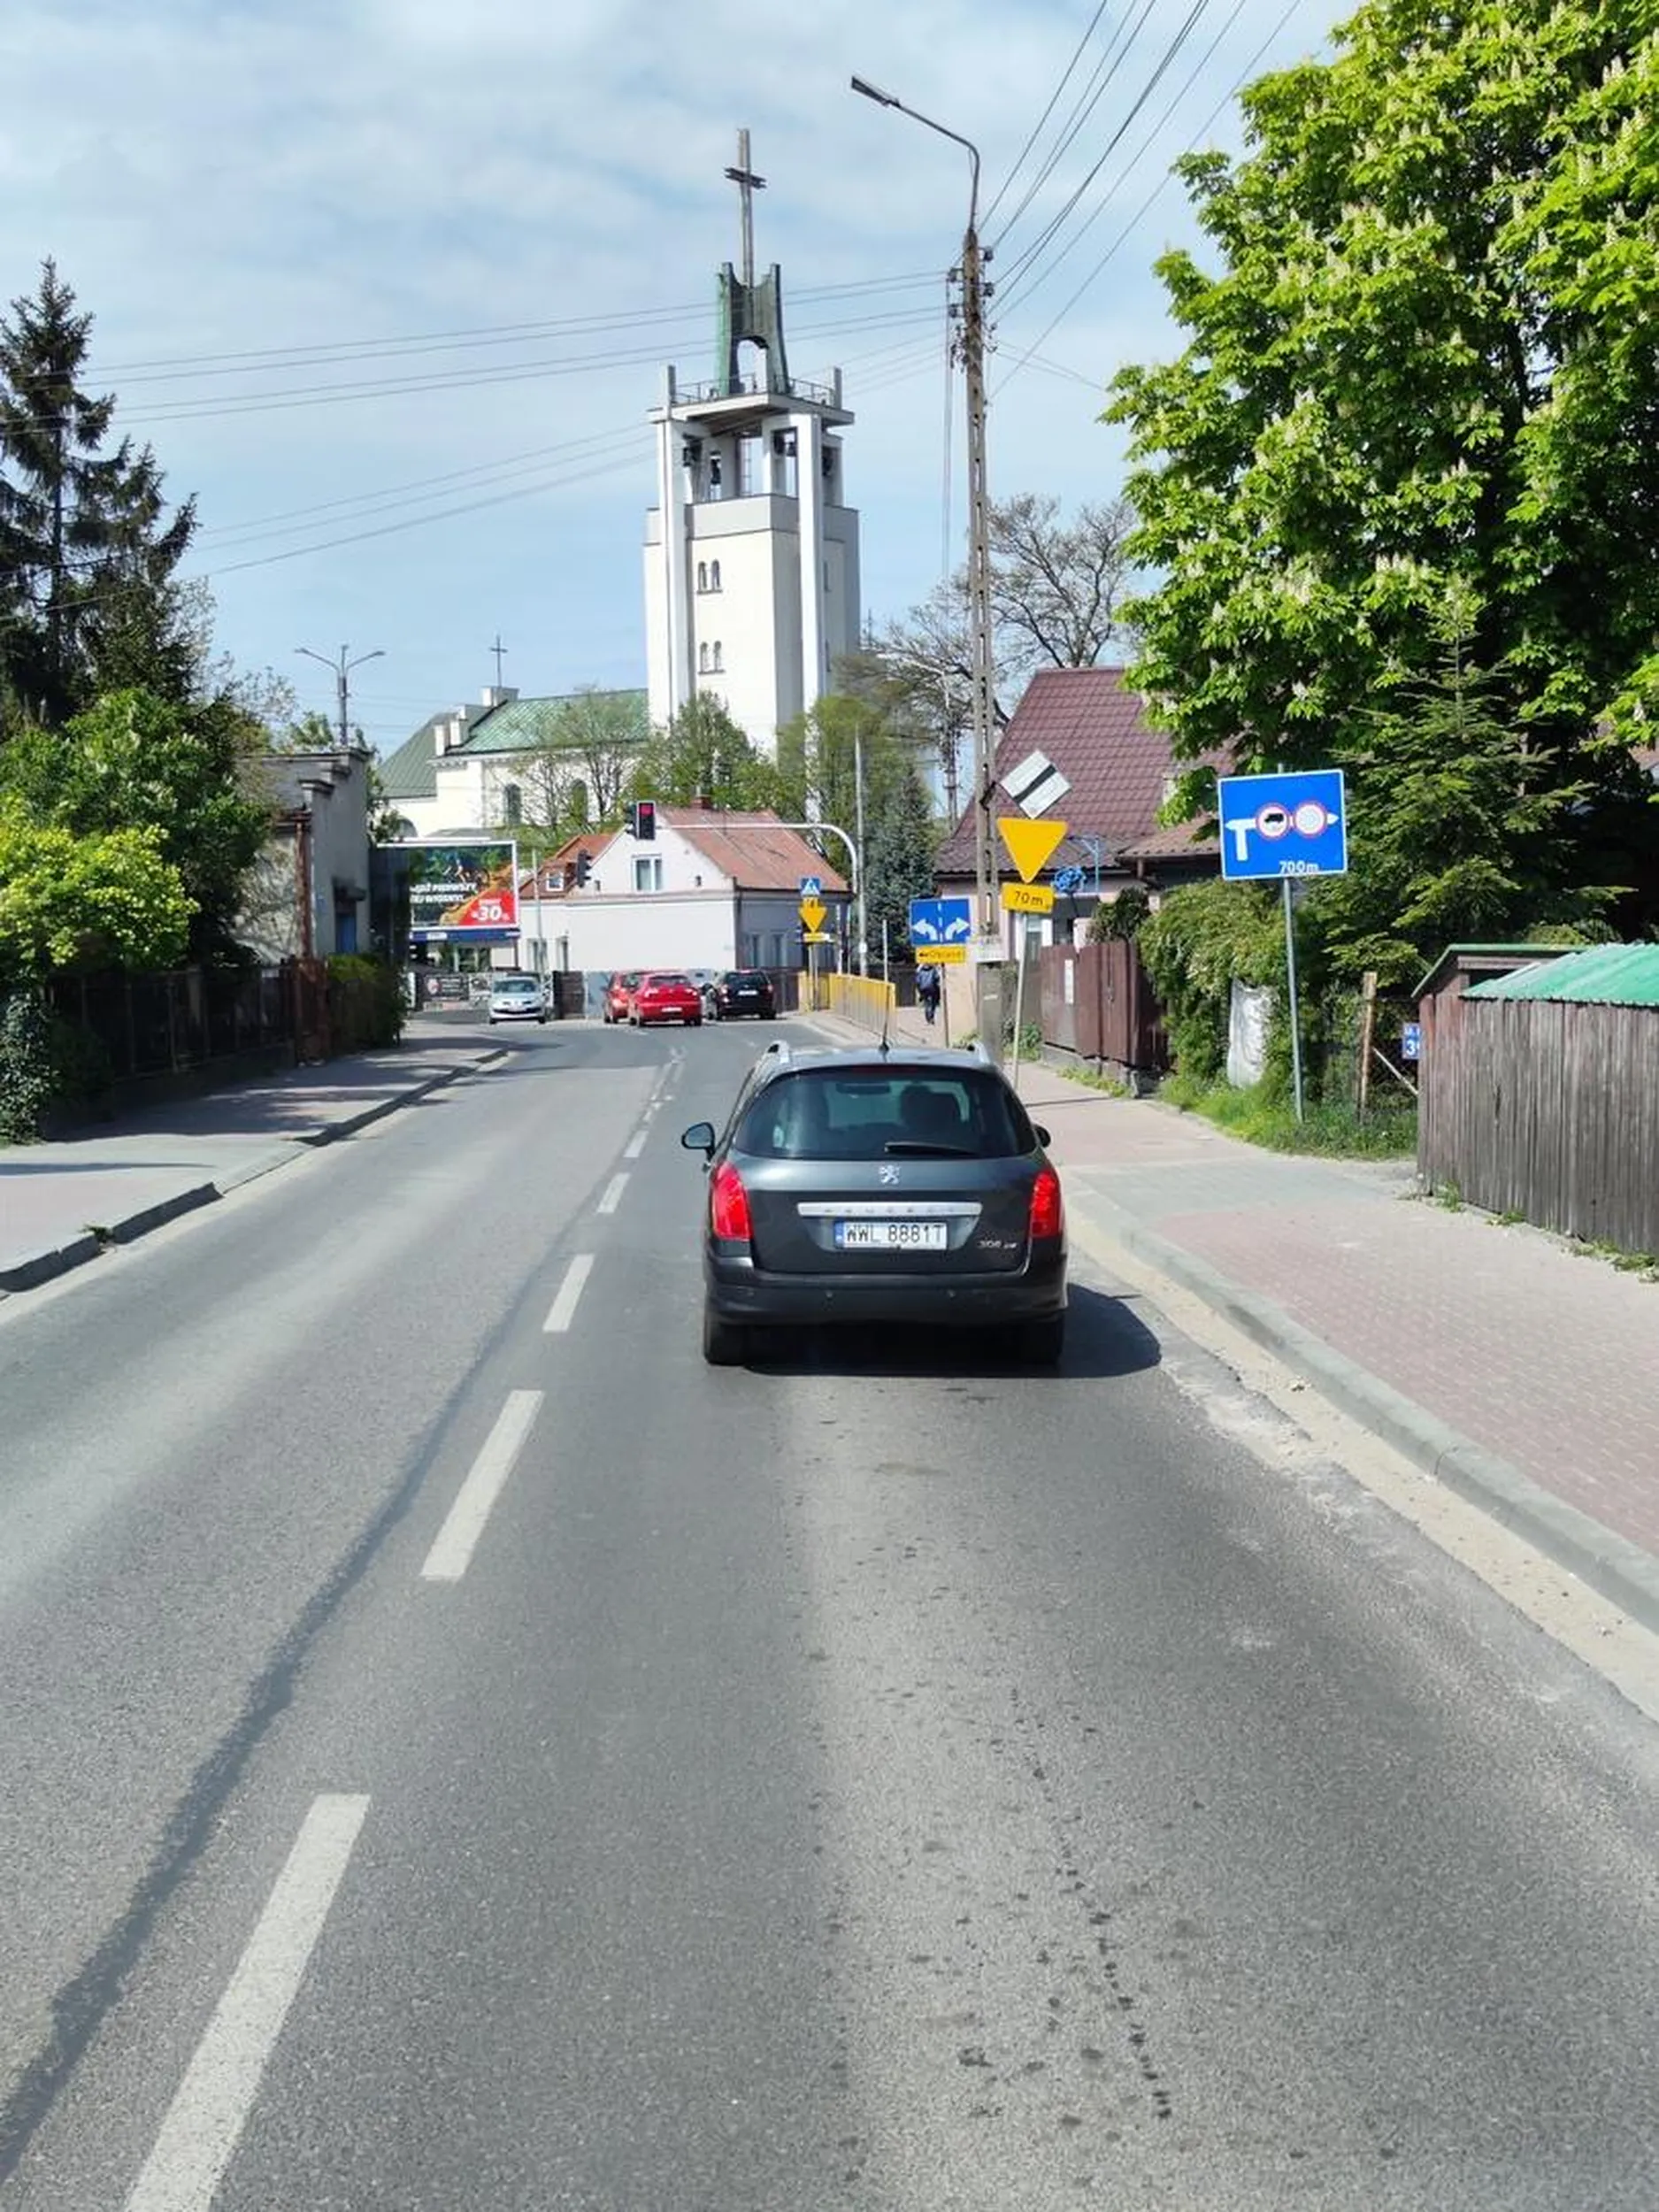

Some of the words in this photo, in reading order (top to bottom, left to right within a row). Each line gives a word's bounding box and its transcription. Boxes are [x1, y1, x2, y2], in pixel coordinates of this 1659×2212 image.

[1279, 860, 1319, 875] 700m
[1015, 890, 1043, 906] 70m
[846, 1224, 880, 1243] WWL
[887, 1224, 945, 1243] 8881T
